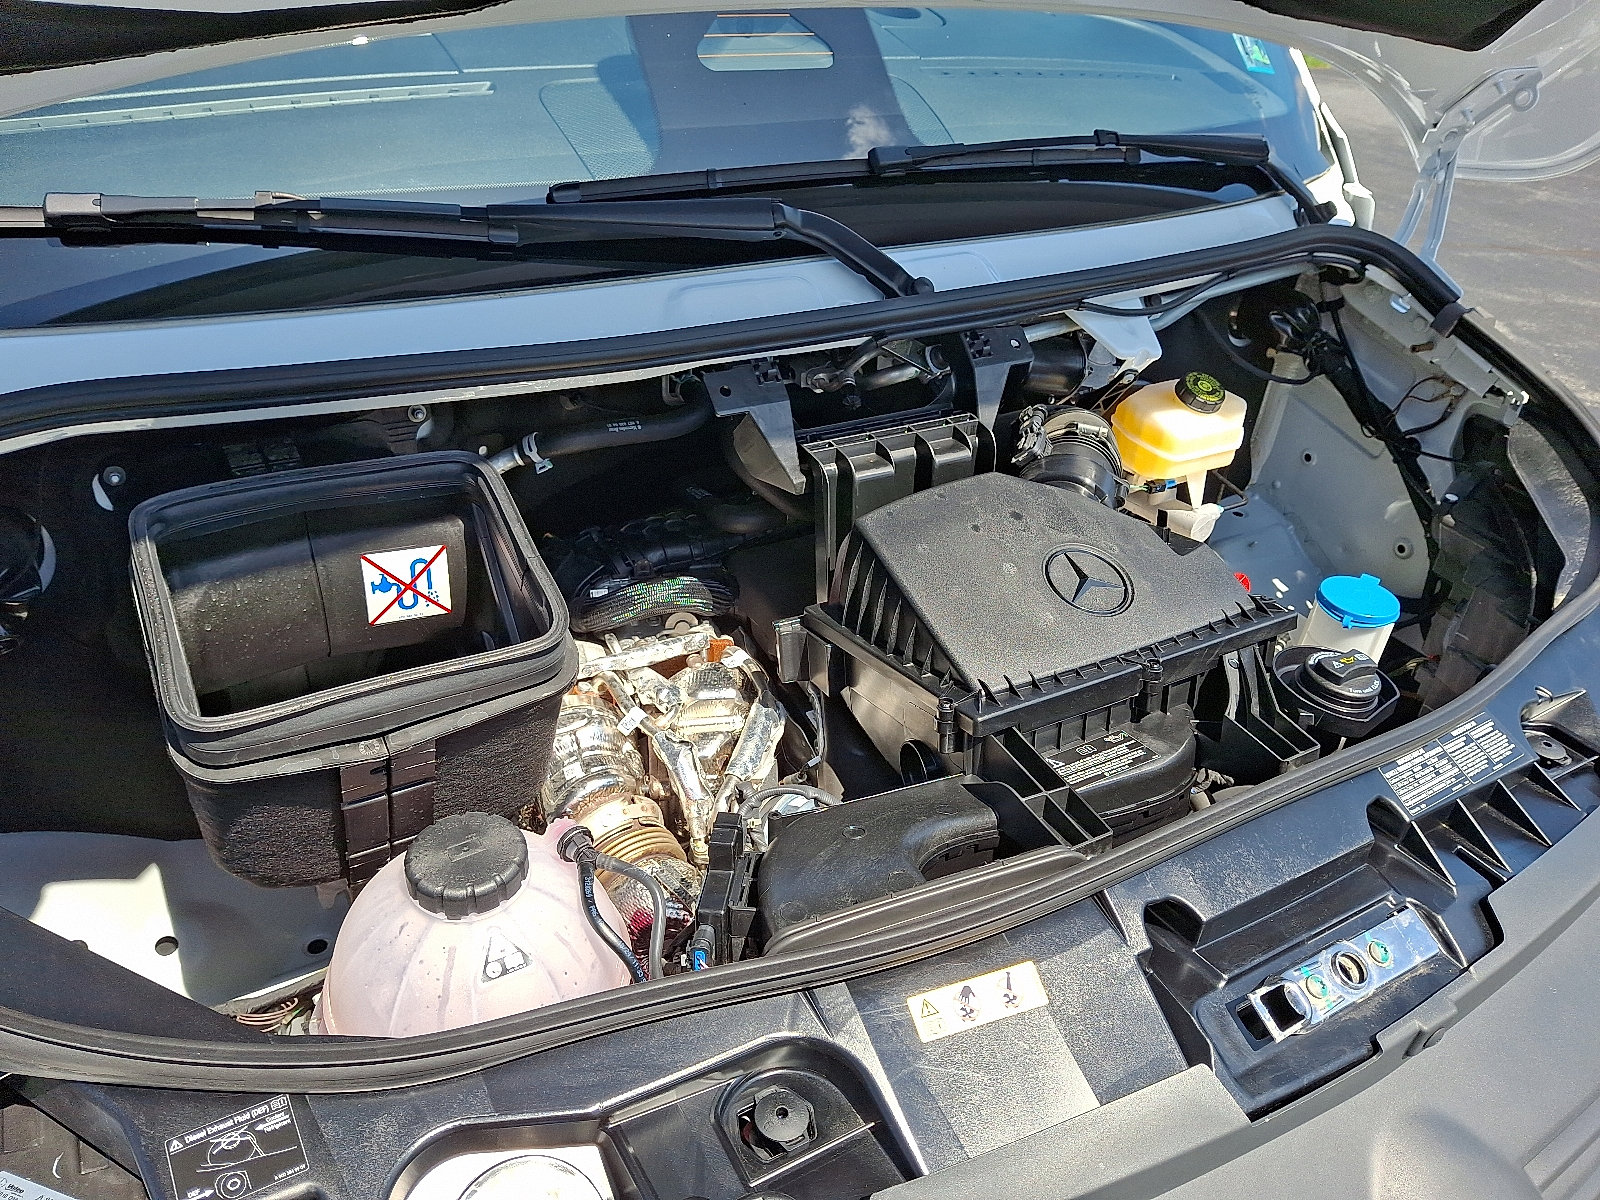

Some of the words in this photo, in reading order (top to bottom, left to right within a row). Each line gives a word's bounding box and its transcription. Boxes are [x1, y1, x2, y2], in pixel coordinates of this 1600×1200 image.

[184, 1129, 207, 1143] Diesel
[206, 1119, 235, 1135] Exhaust
[233, 1112, 251, 1124] Fluid
[251, 1105, 269, 1118] (DEF)
[187, 1188, 200, 1198] DEF
